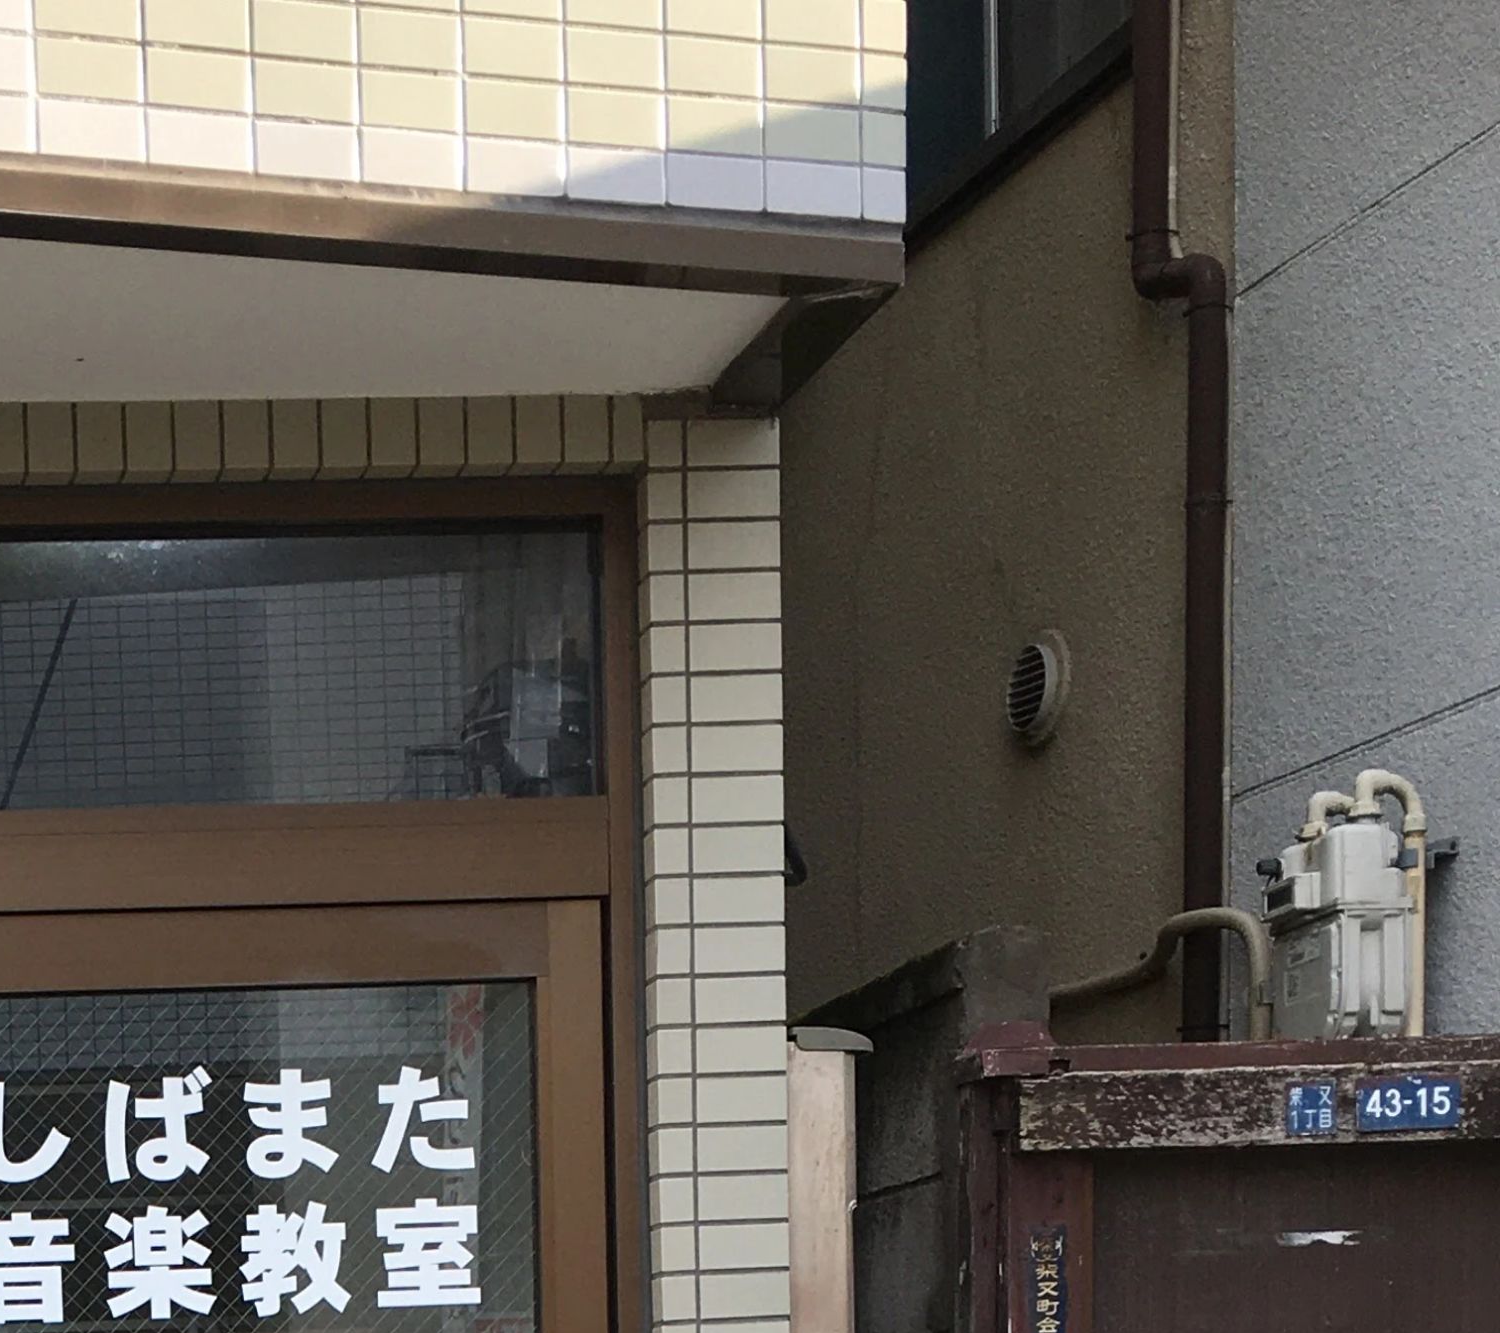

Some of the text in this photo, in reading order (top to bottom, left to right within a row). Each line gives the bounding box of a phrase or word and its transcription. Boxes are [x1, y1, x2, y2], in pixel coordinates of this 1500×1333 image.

[1289, 1085, 1332, 1106] 柴又
[1365, 1086, 1451, 1118] 43-15
[1290, 1108, 1332, 1129] 1丁目
